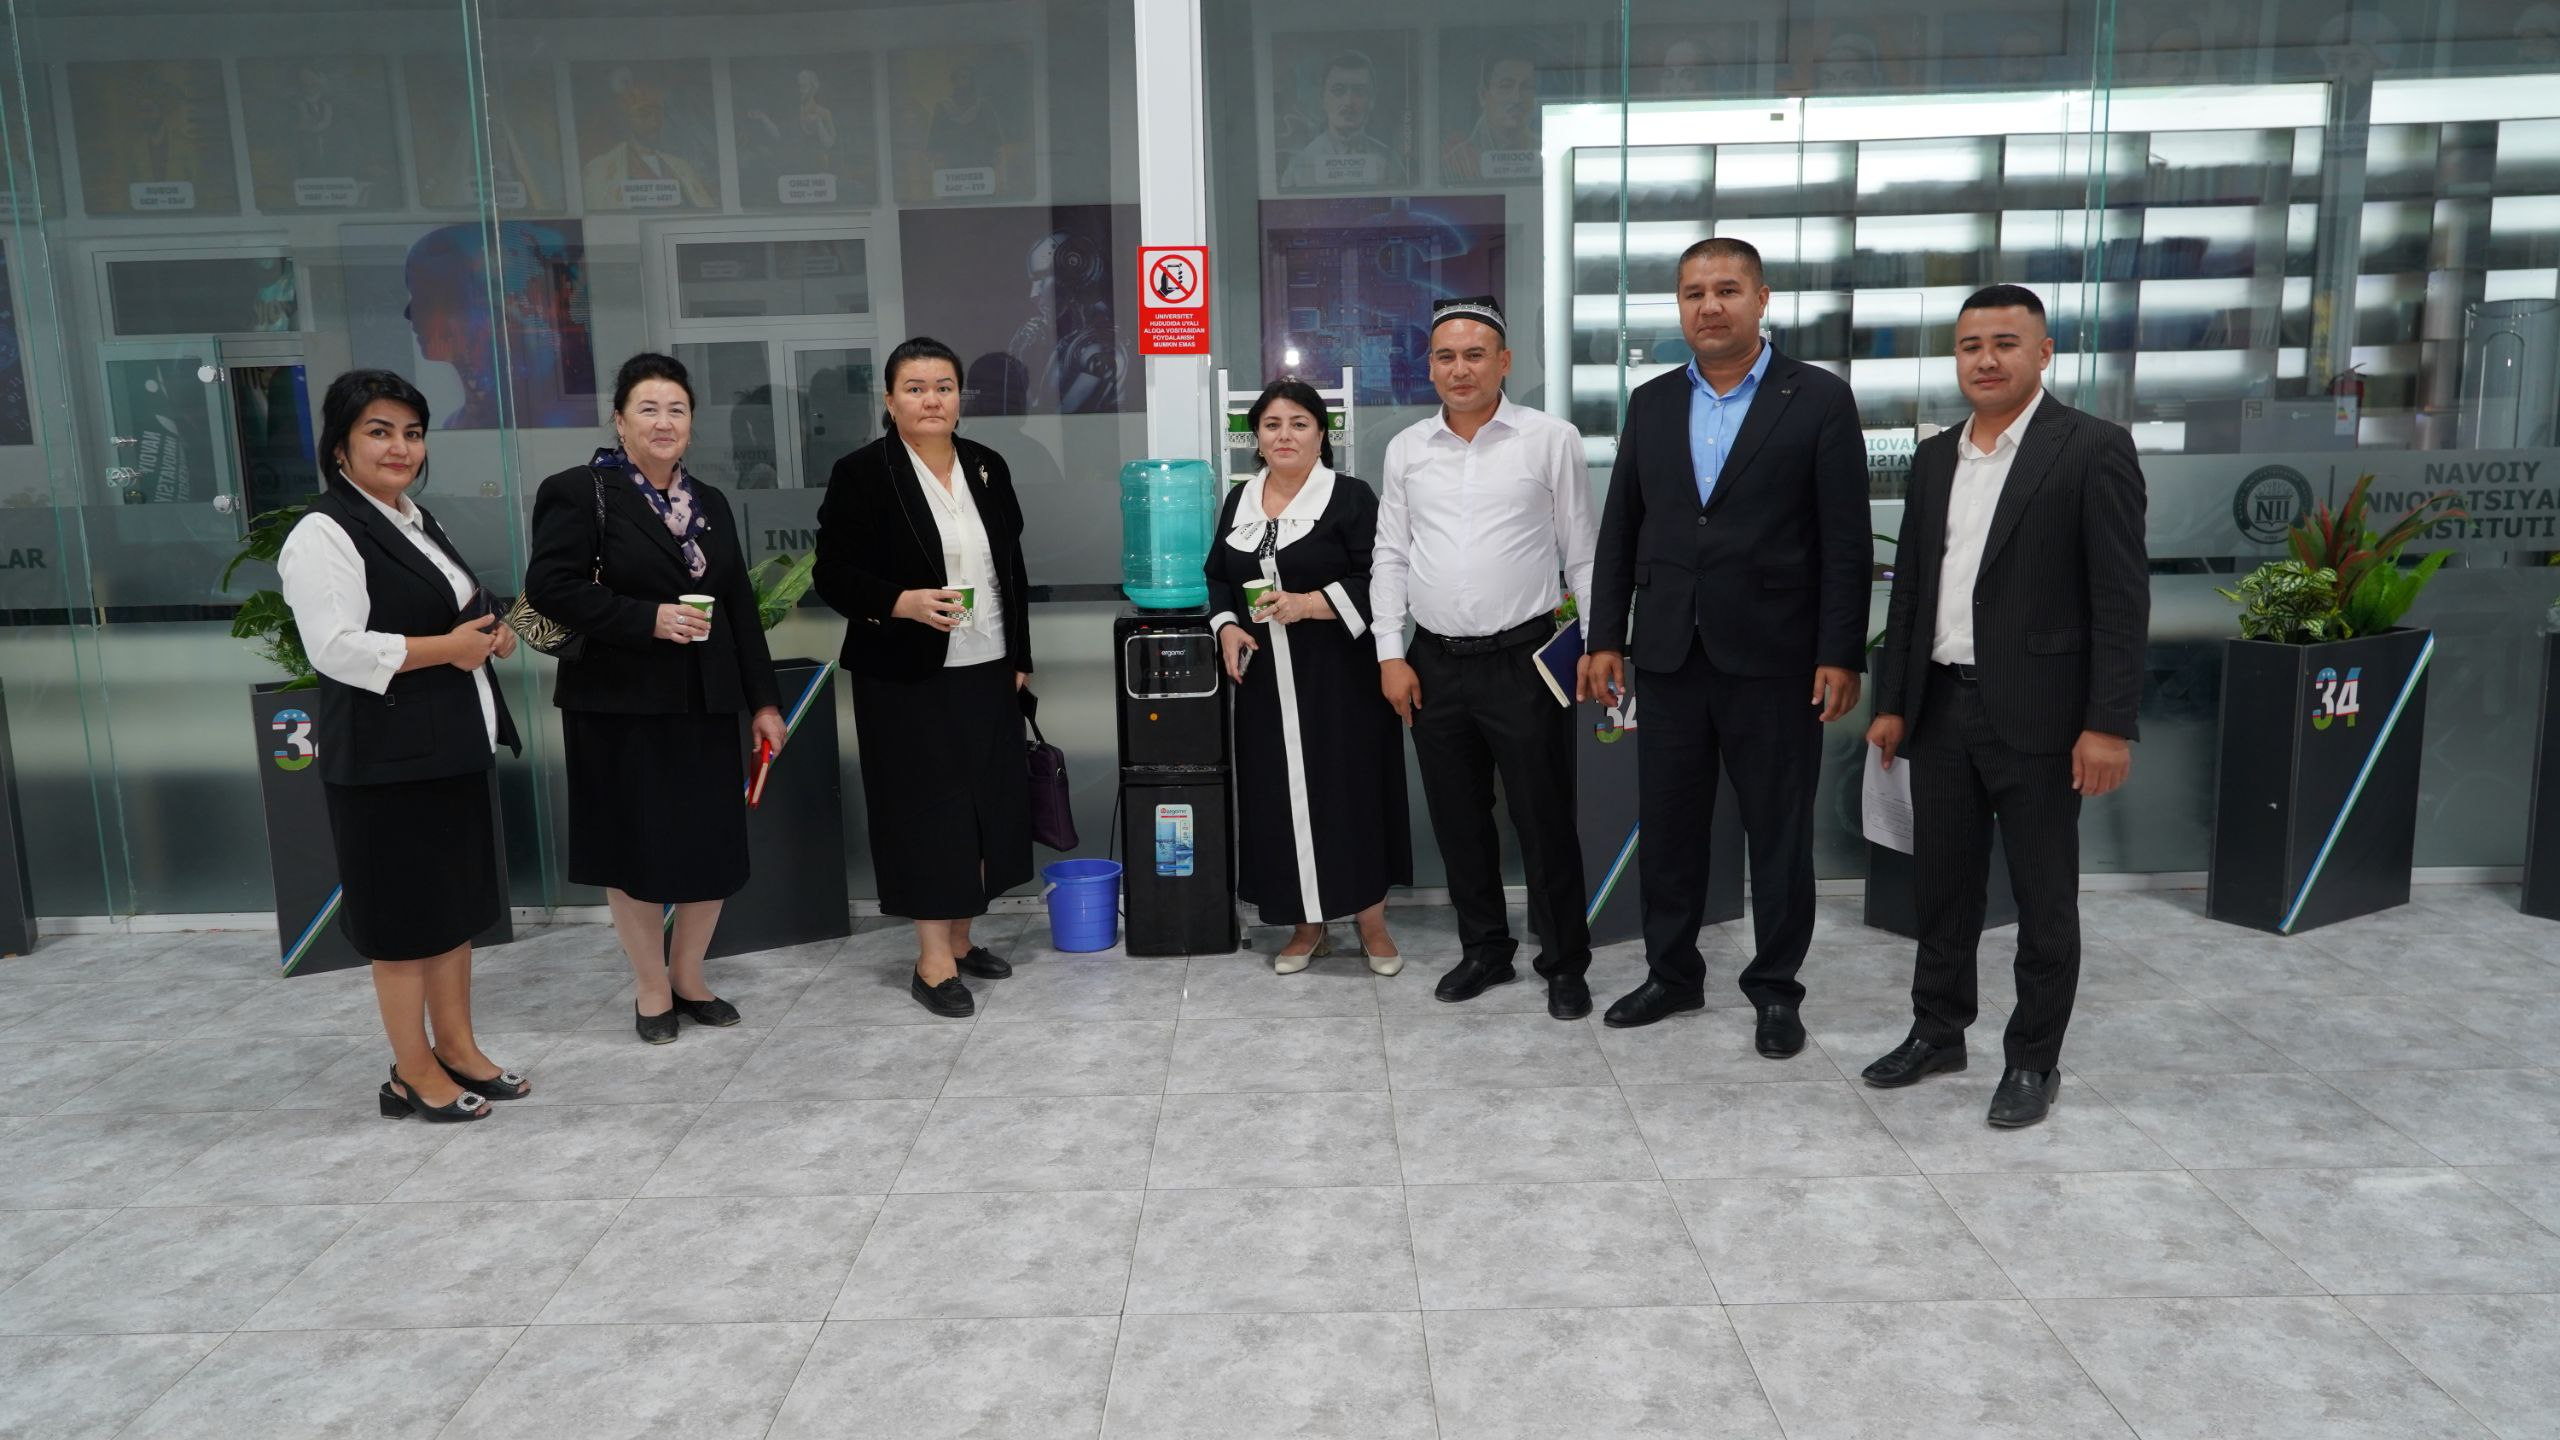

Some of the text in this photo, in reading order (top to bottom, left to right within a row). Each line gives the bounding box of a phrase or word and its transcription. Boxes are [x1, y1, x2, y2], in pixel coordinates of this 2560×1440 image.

[2424, 461, 2541, 484] NAVOIY
[2256, 501, 2289, 520] NII
[2349, 489, 2560, 513] NNOVATSIYA
[2312, 667, 2361, 731] 34
[272, 709, 319, 771] 3
